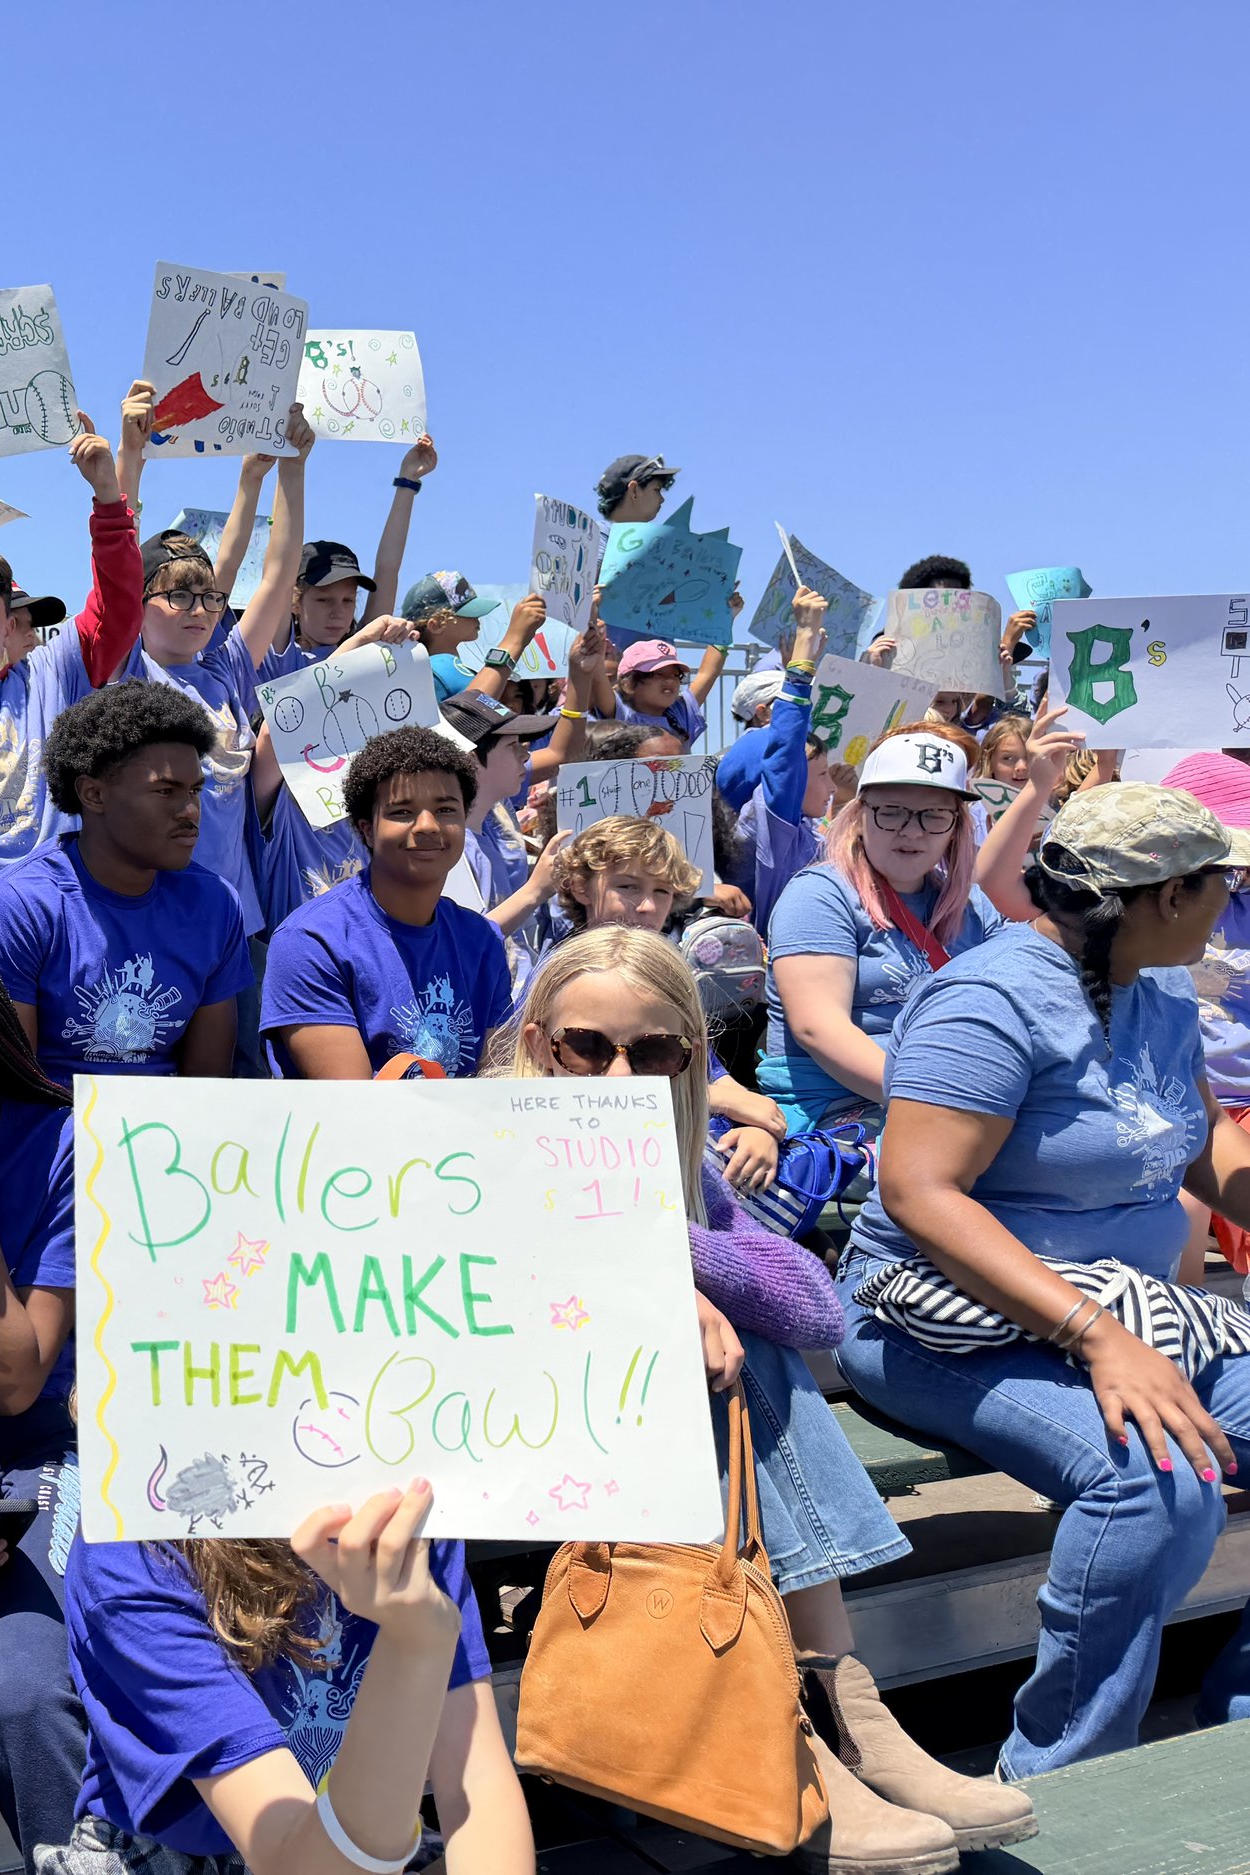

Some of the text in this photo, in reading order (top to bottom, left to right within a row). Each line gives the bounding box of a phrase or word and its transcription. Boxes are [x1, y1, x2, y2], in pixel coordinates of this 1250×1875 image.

[1065, 619, 1167, 726] B's
[914, 743, 954, 774] B's
[510, 1094, 658, 1113] HERE THANKS
[569, 1117, 601, 1130] TO
[535, 1135, 662, 1170] STUDIO
[117, 1111, 482, 1264] Ballers
[285, 1252, 515, 1339] MAKE
[130, 1341, 329, 1410] THEM
